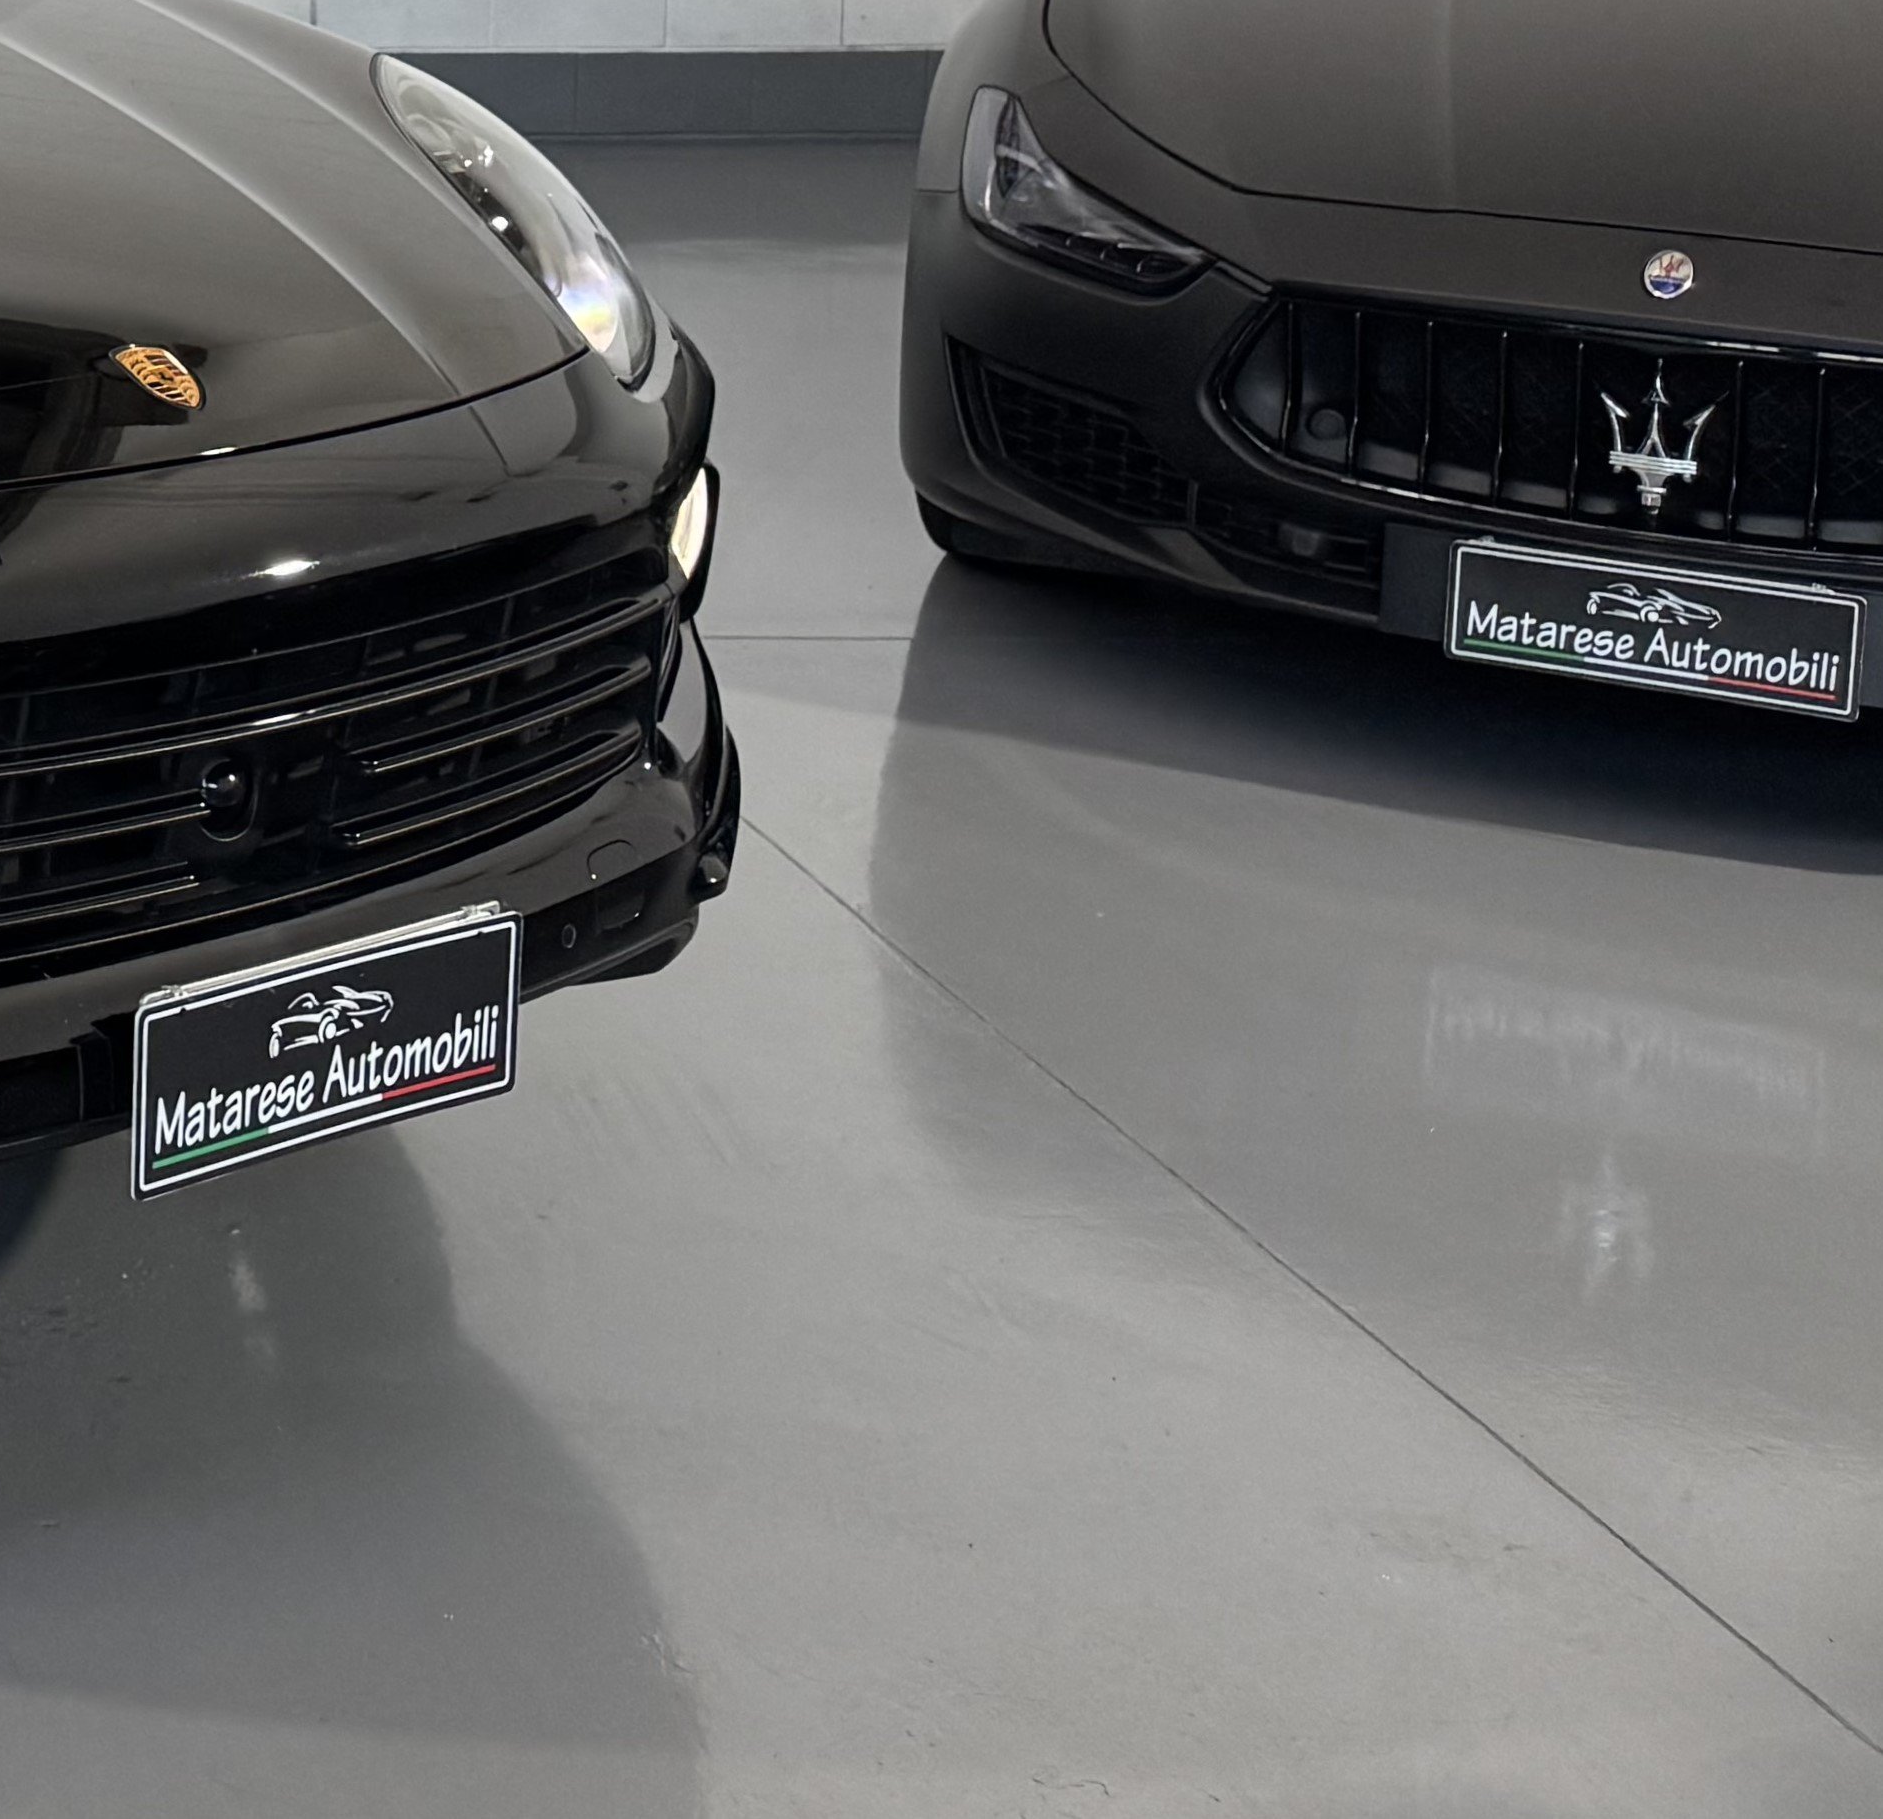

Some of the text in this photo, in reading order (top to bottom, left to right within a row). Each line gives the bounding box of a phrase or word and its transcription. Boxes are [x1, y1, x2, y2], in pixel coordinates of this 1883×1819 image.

[1466, 600, 1841, 693] Matarese Automobili
[153, 1004, 500, 1155] Matarese Automobili
